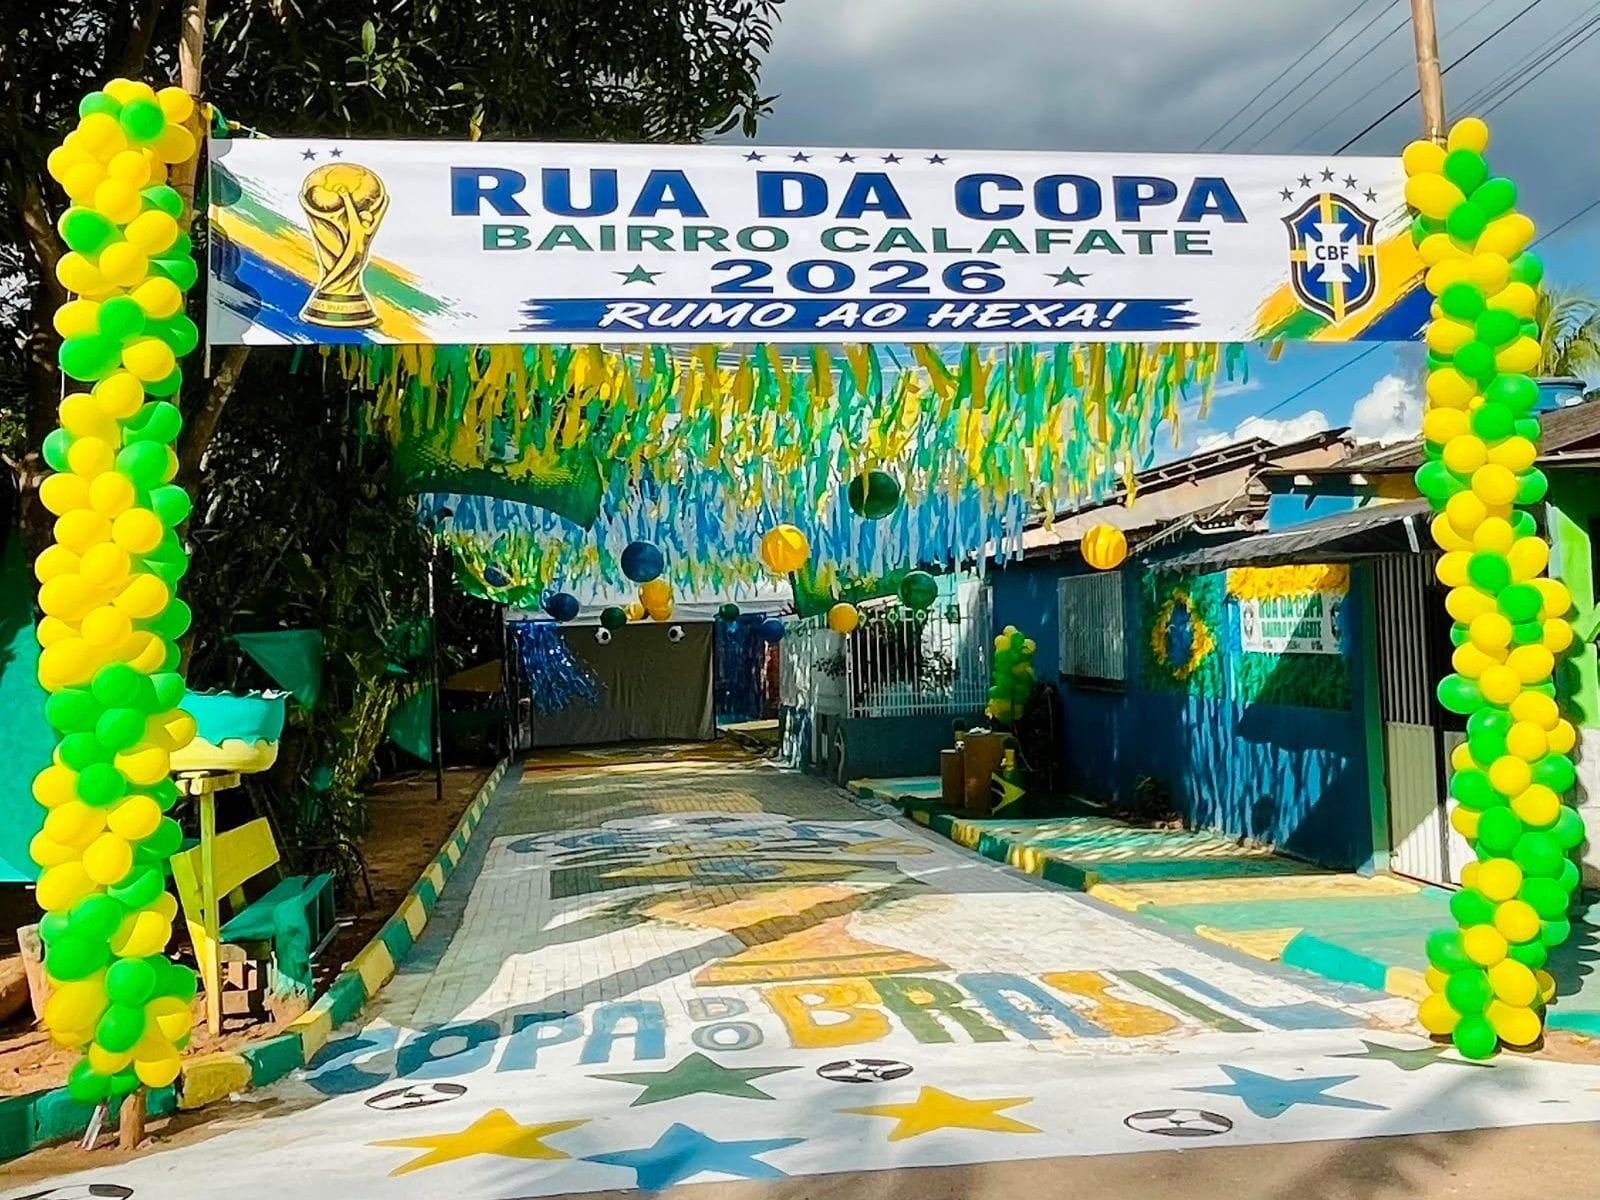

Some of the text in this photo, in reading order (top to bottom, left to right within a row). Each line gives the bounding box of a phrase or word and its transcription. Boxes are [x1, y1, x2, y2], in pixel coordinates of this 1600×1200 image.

[450, 167, 1248, 223] RUA DA COPA
[482, 224, 1213, 255] BAIRRO CALAFATE
[1315, 245, 1349, 261] CBF
[711, 260, 1006, 295] 2026
[597, 301, 1129, 329] RUMO AO HEXA!
[1259, 593, 1324, 618] RUA DA COPA
[302, 1001, 666, 1095] COPA
[760, 968, 1366, 1049] BRASIL
